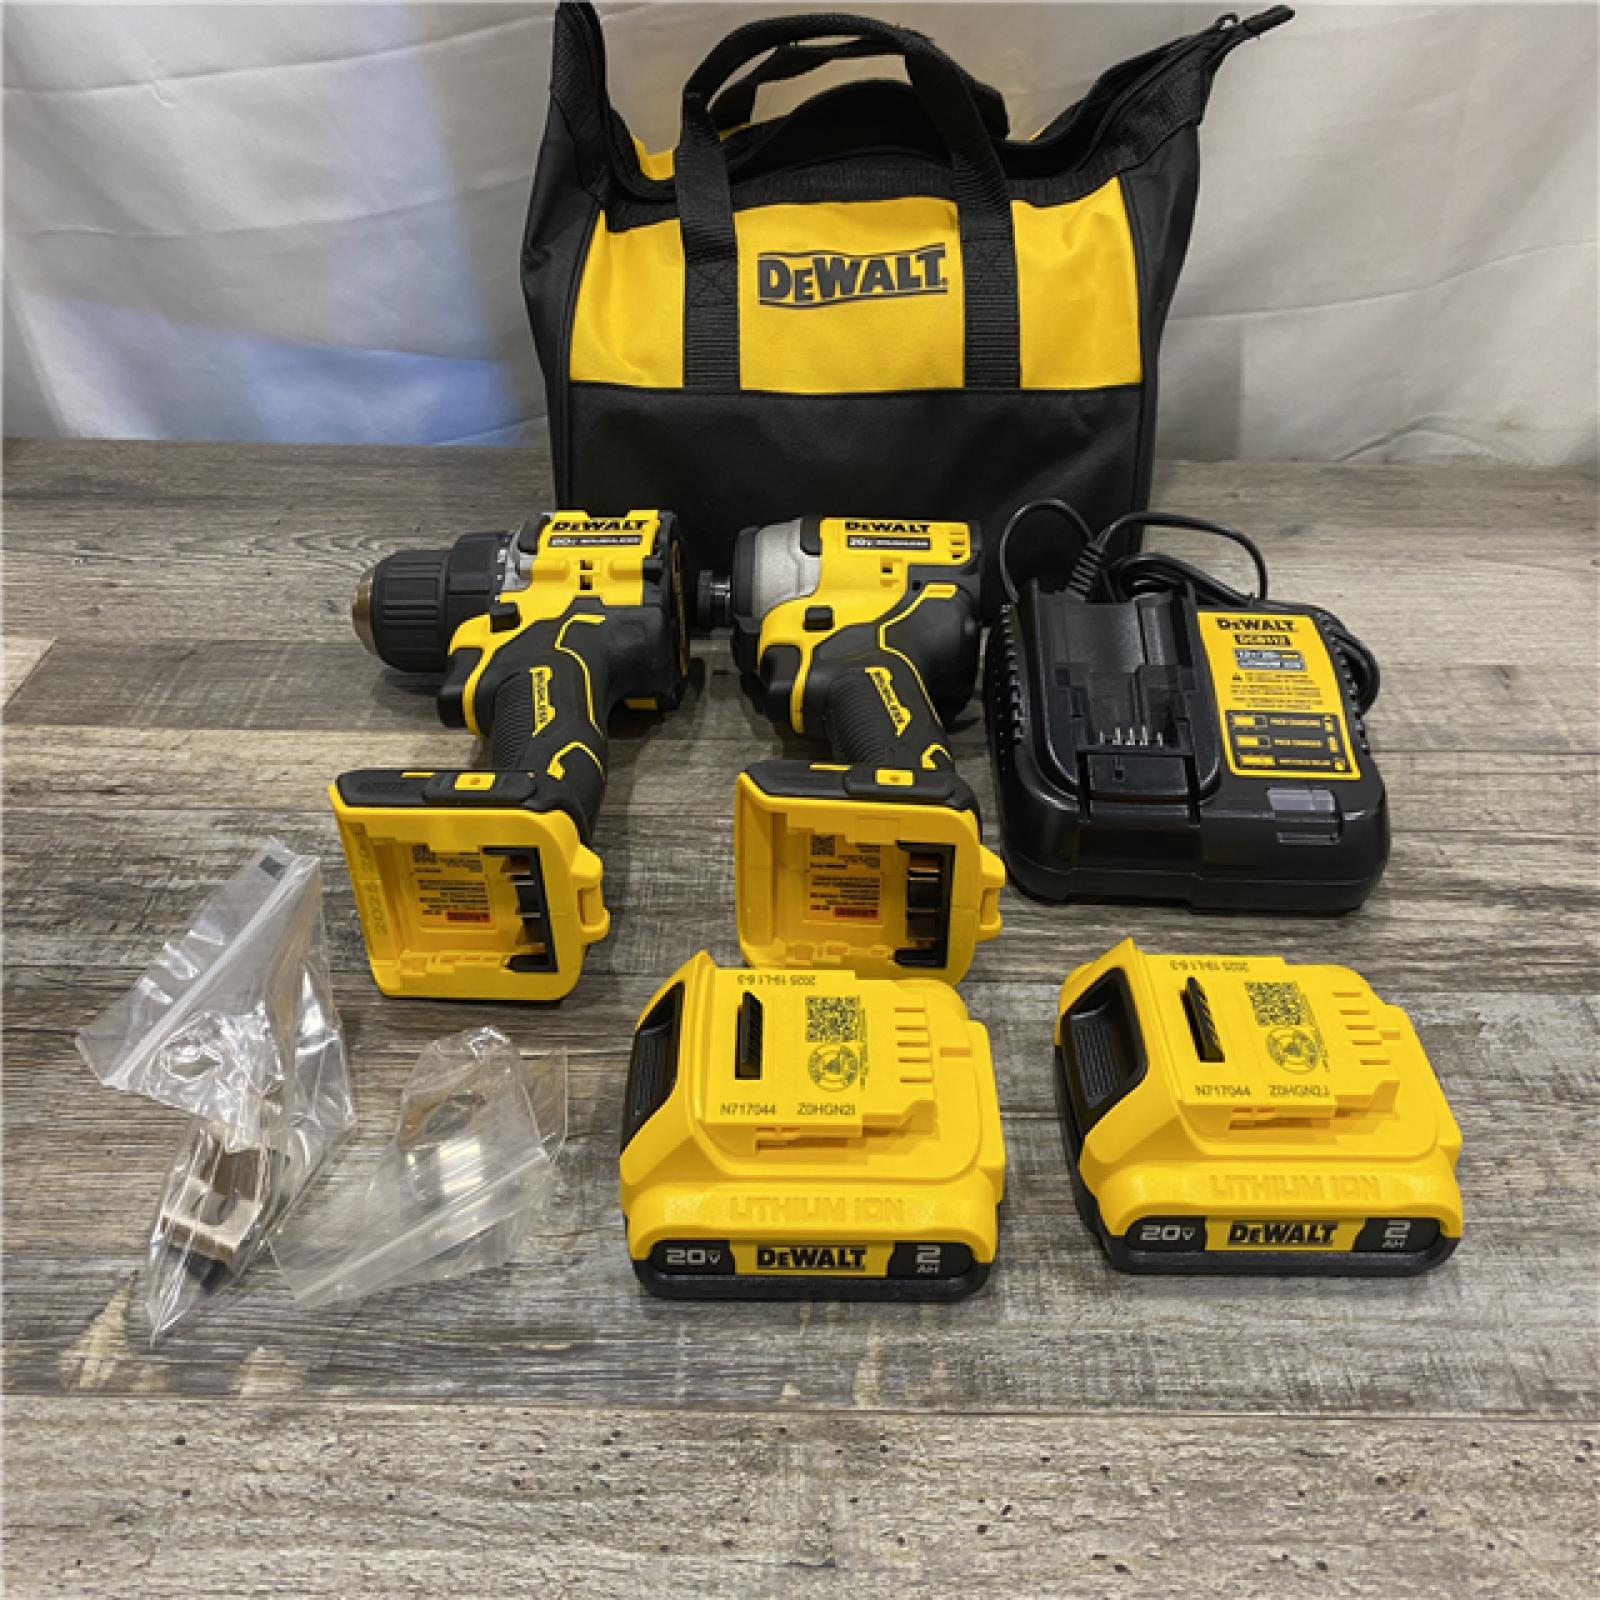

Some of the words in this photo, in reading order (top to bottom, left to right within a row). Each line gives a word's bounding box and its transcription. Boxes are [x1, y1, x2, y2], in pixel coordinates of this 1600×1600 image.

[757, 243, 948, 304] DEWALT
[1208, 1174, 1326, 1201] LITHIUM
[1329, 1174, 1383, 1201] ION
[729, 1196, 850, 1225] LITHIUM
[853, 1196, 905, 1225] ION
[1228, 1221, 1338, 1245] DEWALT
[757, 1246, 867, 1270] DEWALT
